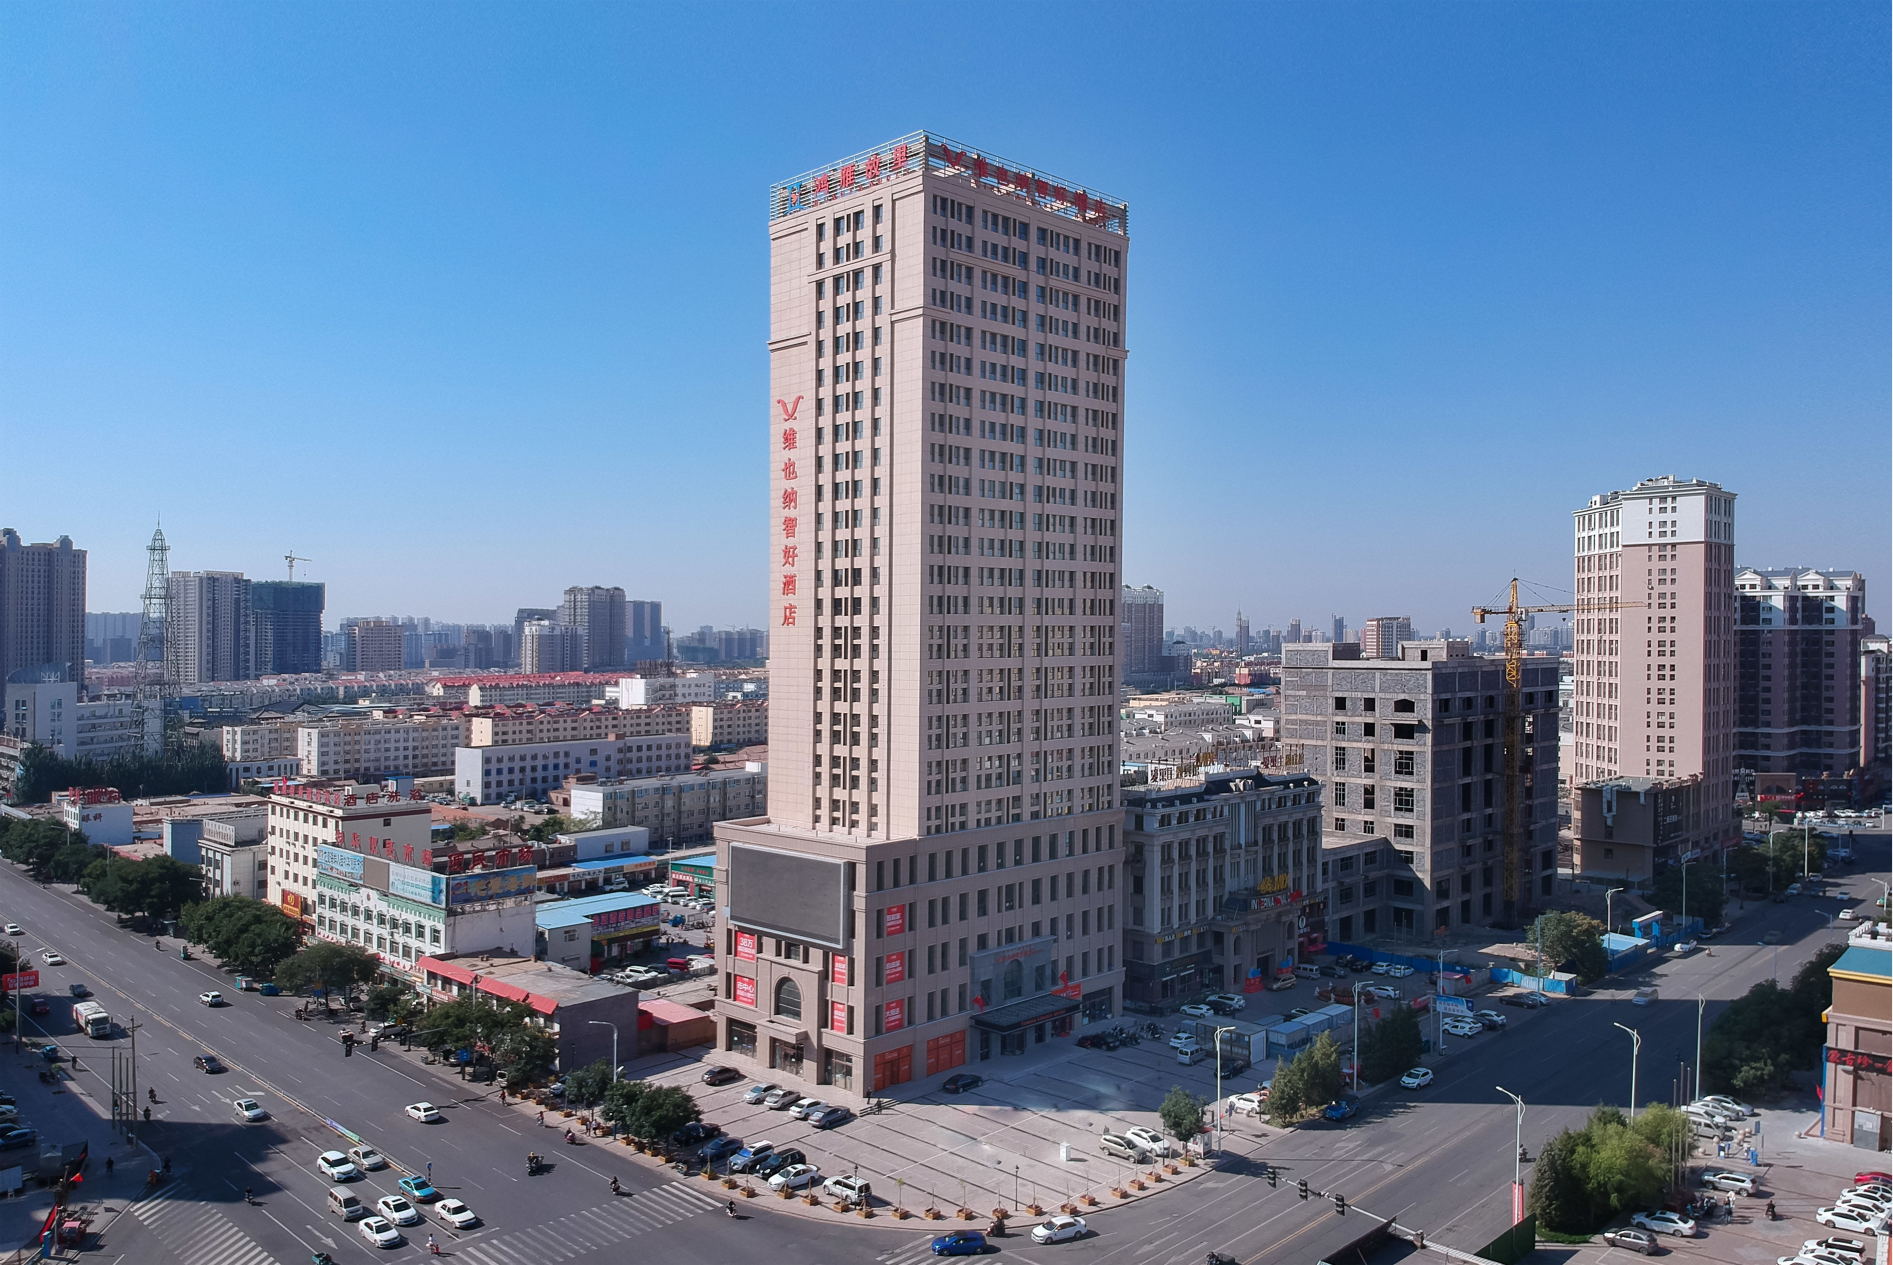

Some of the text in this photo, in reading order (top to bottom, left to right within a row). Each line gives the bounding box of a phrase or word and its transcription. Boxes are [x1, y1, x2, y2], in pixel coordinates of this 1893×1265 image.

[814, 144, 908, 193] 鸿雁故里
[781, 428, 798, 626] 维也纳智好酒店
